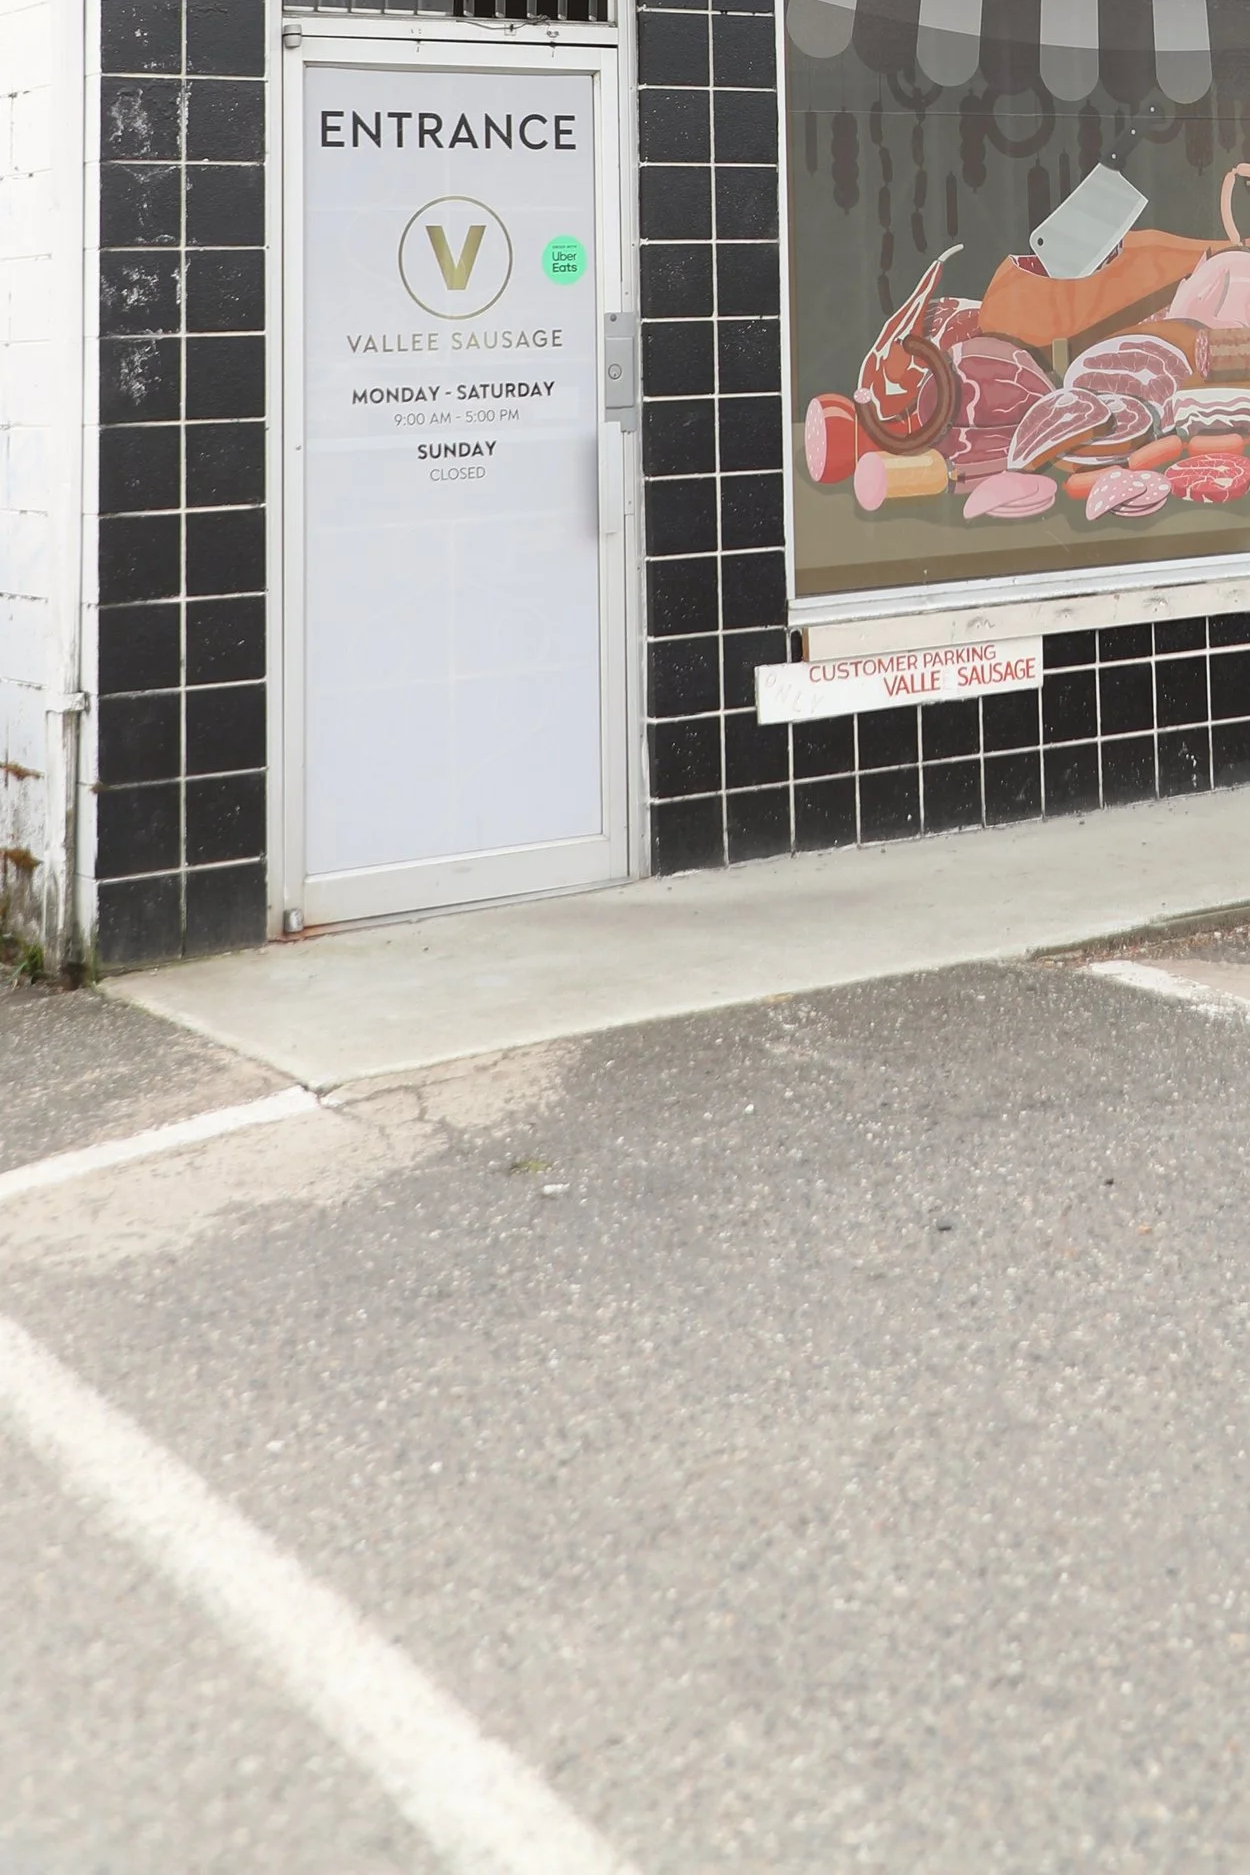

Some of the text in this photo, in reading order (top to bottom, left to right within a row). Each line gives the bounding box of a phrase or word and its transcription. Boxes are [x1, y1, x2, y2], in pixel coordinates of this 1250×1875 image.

[320, 109, 577, 151] ENTRANCE
[425, 224, 490, 291] V
[552, 251, 578, 262] Uber
[552, 262, 578, 273] Eats
[347, 328, 563, 354] VALLEE SAUSAGE
[351, 385, 441, 405] MONDAY
[456, 380, 556, 401] SATURDAY
[394, 412, 426, 427] 9:00
[429, 411, 452, 425] AM
[465, 408, 496, 423] 5:00
[499, 408, 520, 421] PM
[417, 439, 498, 460] SUNDAY
[430, 465, 486, 482] CLOSED
[808, 643, 997, 683] CUSTOMER PARKING
[882, 656, 1037, 698] VALLE SAUSAGE
